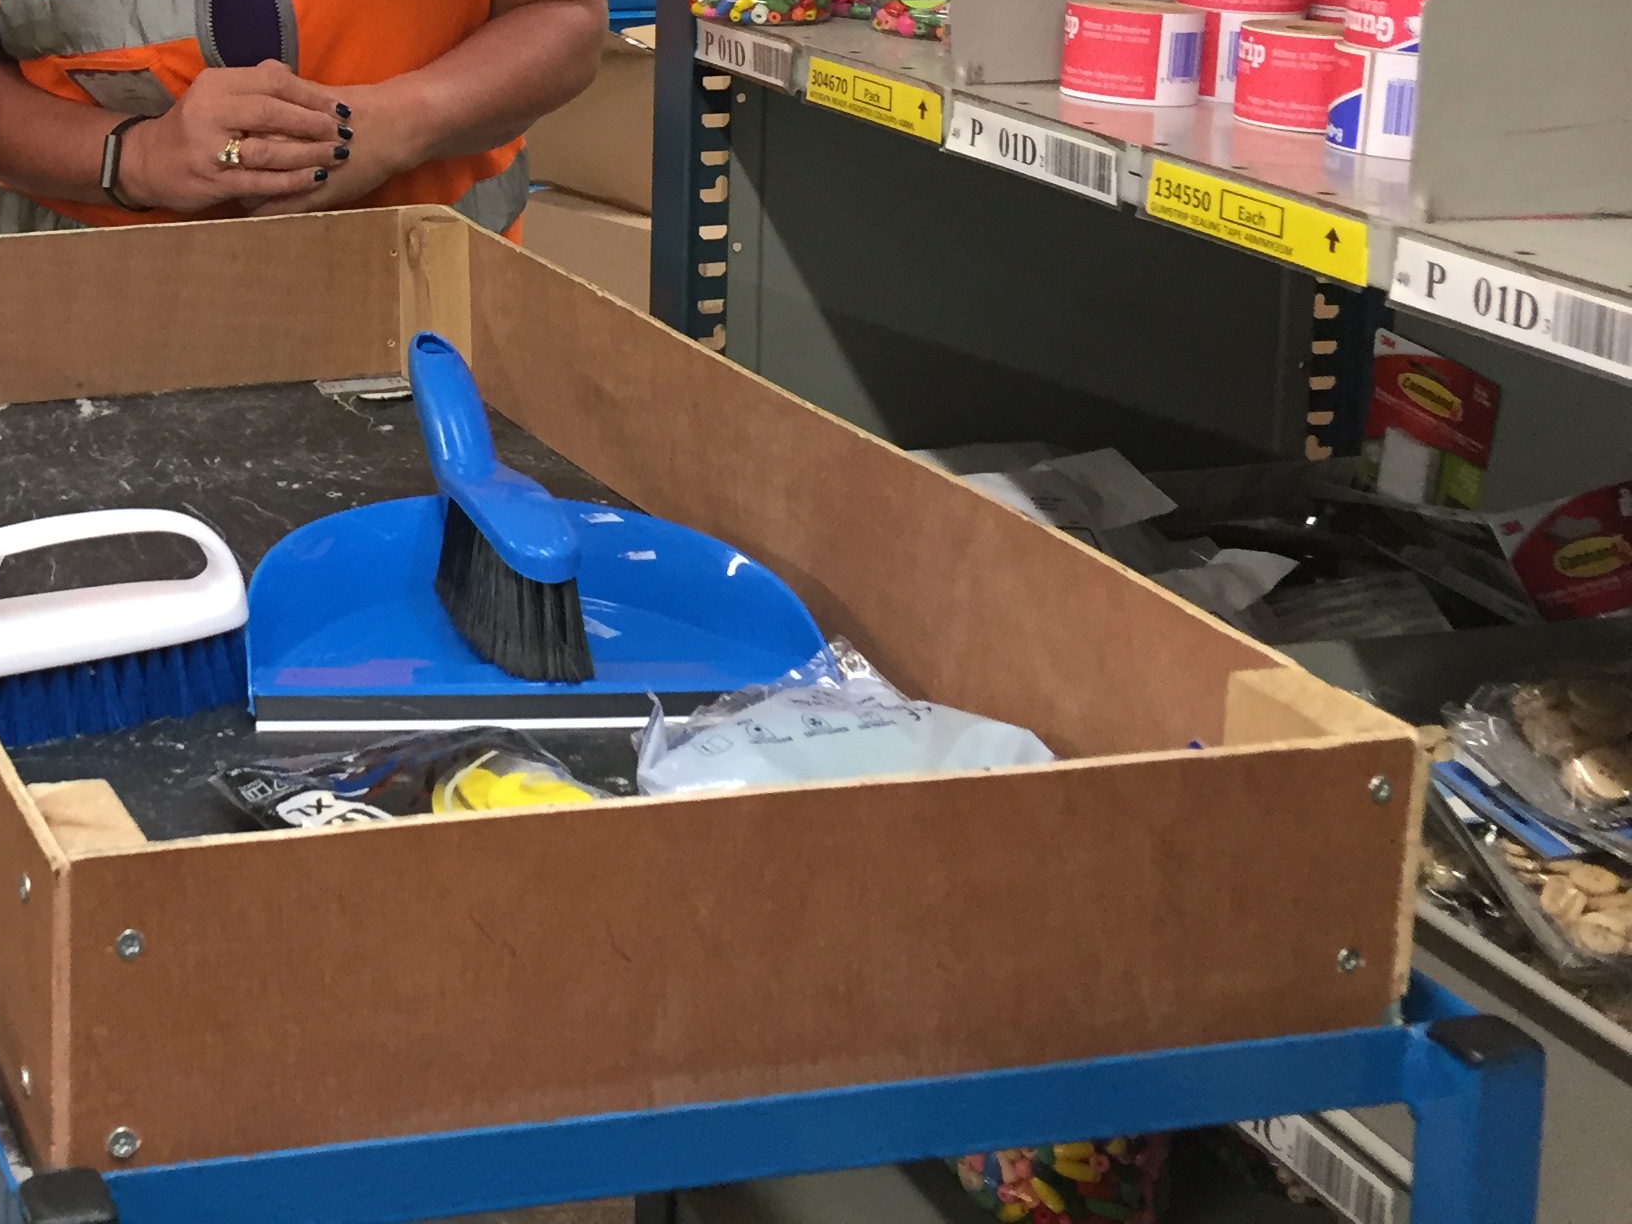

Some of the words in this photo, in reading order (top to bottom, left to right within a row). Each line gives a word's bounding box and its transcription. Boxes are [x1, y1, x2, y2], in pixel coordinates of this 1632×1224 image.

[705, 30, 714, 56] P
[718, 38, 746, 67] 01D
[811, 69, 848, 95] 304670
[864, 88, 881, 103] Pack
[970, 117, 983, 148] P
[999, 131, 1037, 166] 01D
[1154, 177, 1212, 212] 134550
[1238, 205, 1266, 228] Each
[1425, 261, 1446, 300] P
[1473, 277, 1540, 331] 01D
